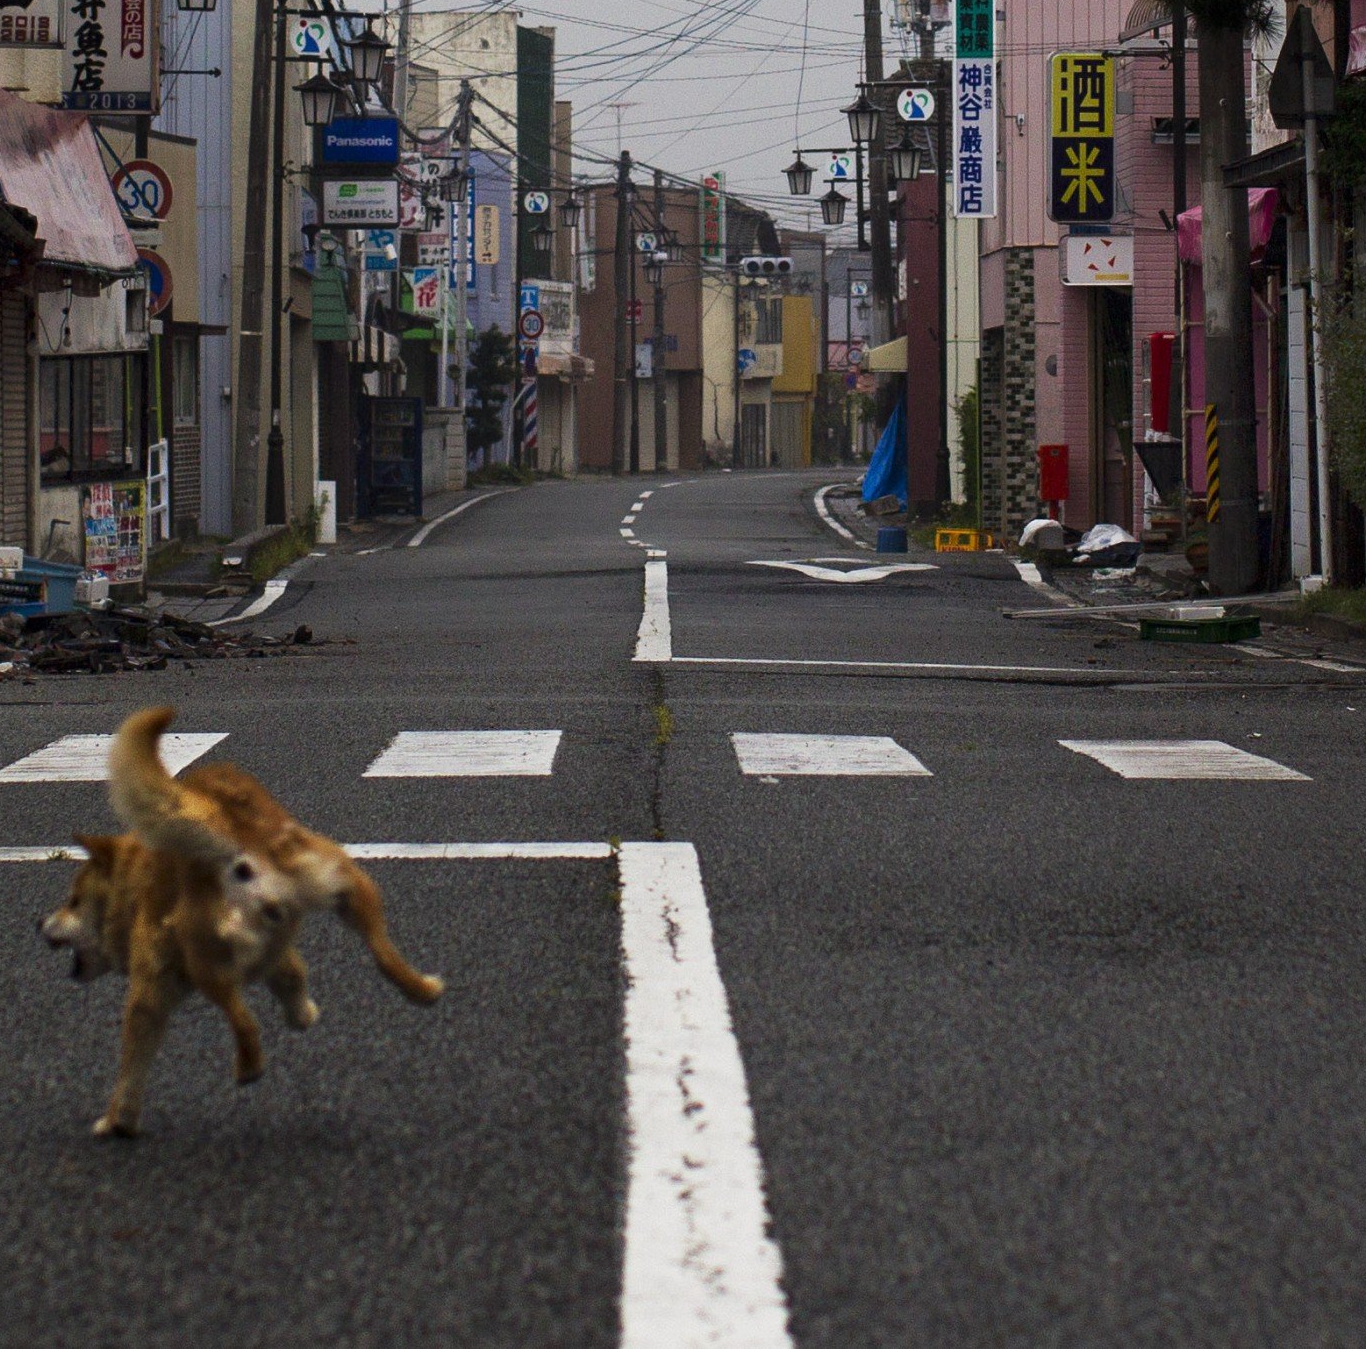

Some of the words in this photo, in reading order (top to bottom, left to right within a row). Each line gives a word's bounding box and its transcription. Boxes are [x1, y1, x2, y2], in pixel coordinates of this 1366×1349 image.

[90, 93, 136, 109] 2013
[1061, 59, 1105, 132] 酒
[327, 135, 393, 147] Panasonic
[1061, 143, 1105, 213] 米
[125, 180, 158, 209] 30
[525, 319, 539, 331] 30
